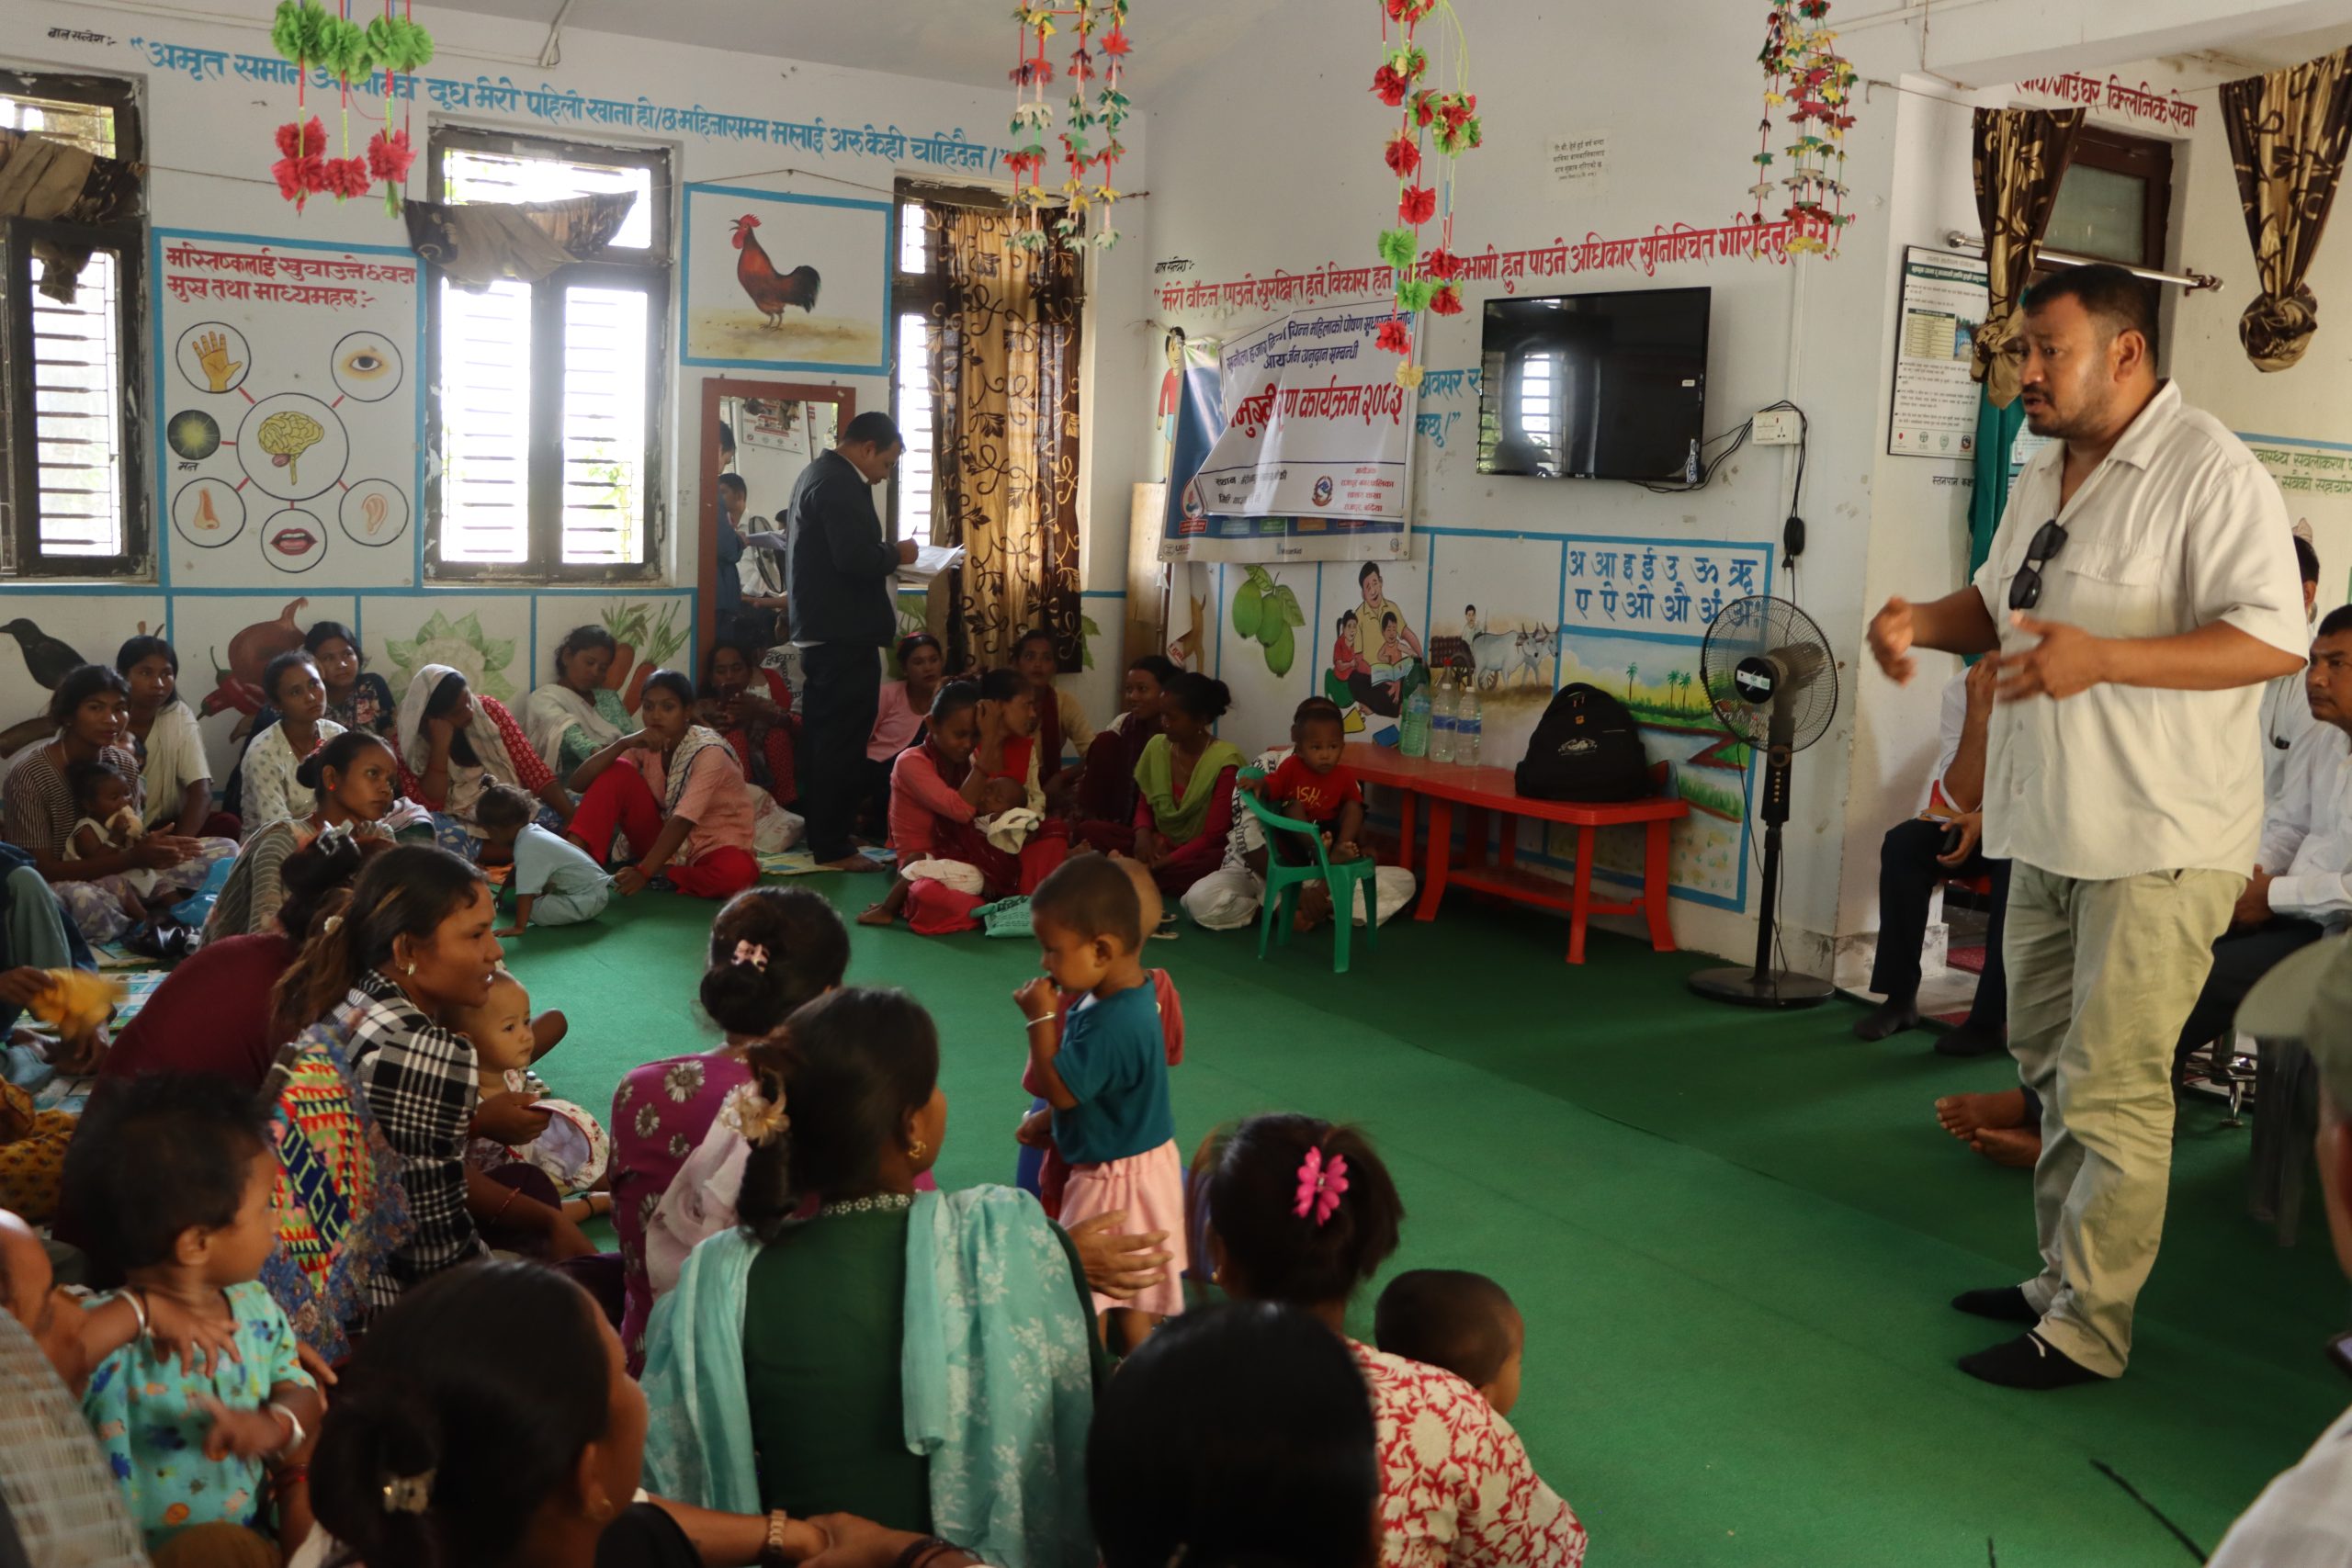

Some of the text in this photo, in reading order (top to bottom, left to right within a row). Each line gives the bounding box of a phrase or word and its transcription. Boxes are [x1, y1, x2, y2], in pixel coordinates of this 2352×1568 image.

[424, 77, 474, 111] दूध
[474, 75, 522, 112] मेरो
[524, 83, 585, 126] पहिलो
[771, 118, 826, 161] मलाई
[1500, 251, 1526, 295] हुन
[1528, 236, 1569, 276] पाउने
[1568, 231, 1640, 274] अधिकार
[210, 279, 251, 301] तथा
[1299, 374, 1363, 421] कार्यक्रम
[177, 461, 199, 472] मन
[1567, 550, 1587, 577] अ
[1590, 551, 1618, 580] आ
[1623, 553, 1637, 585] इ
[1641, 547, 1657, 587] ई
[1661, 555, 1680, 581] उ
[1690, 557, 1719, 584] ऊ
[1575, 588, 1592, 619] ए
[1600, 581, 1619, 621] ऐ
[1622, 583, 1655, 620] ओ
[1660, 581, 1692, 623] औ
[1695, 588, 1723, 625] अं
